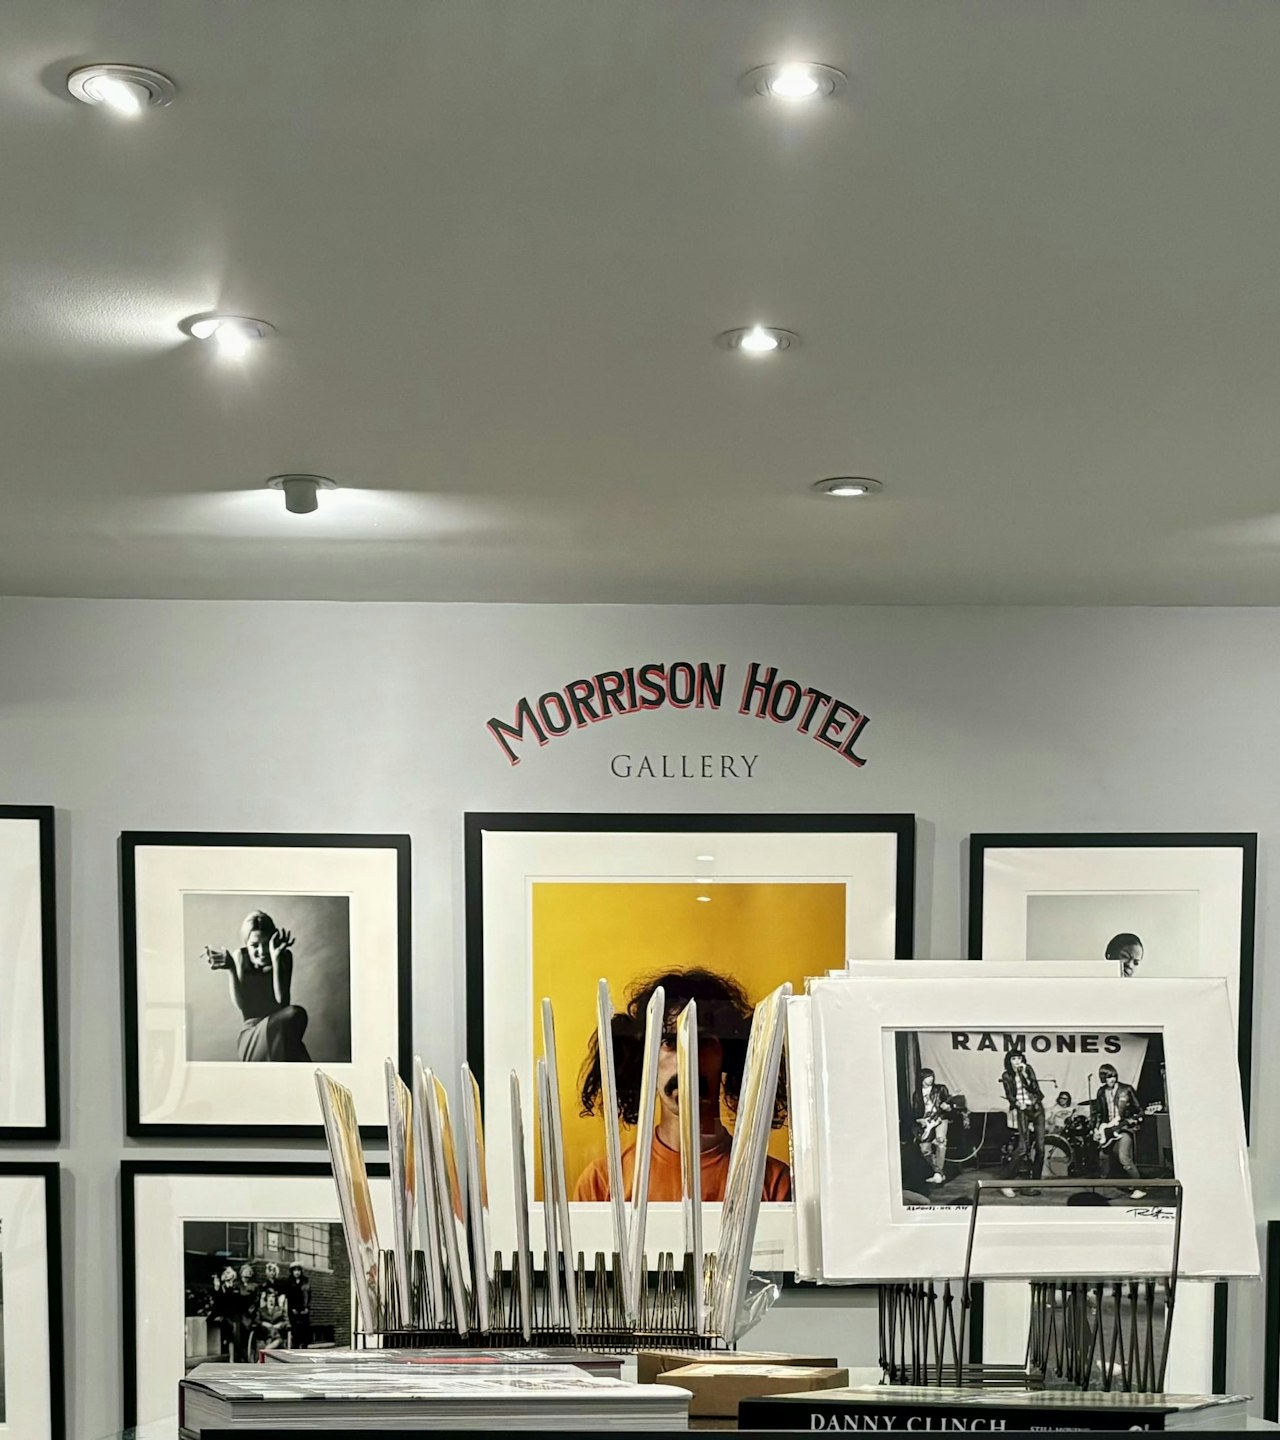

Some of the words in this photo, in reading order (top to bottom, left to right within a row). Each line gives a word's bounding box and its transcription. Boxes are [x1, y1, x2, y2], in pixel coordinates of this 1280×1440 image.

[486, 662, 726, 766] MORRISON
[738, 662, 872, 768] HOTEL
[610, 754, 759, 778] GALLERY
[951, 1031, 1121, 1053] RAMONES
[810, 1413, 897, 1432] DANNY
